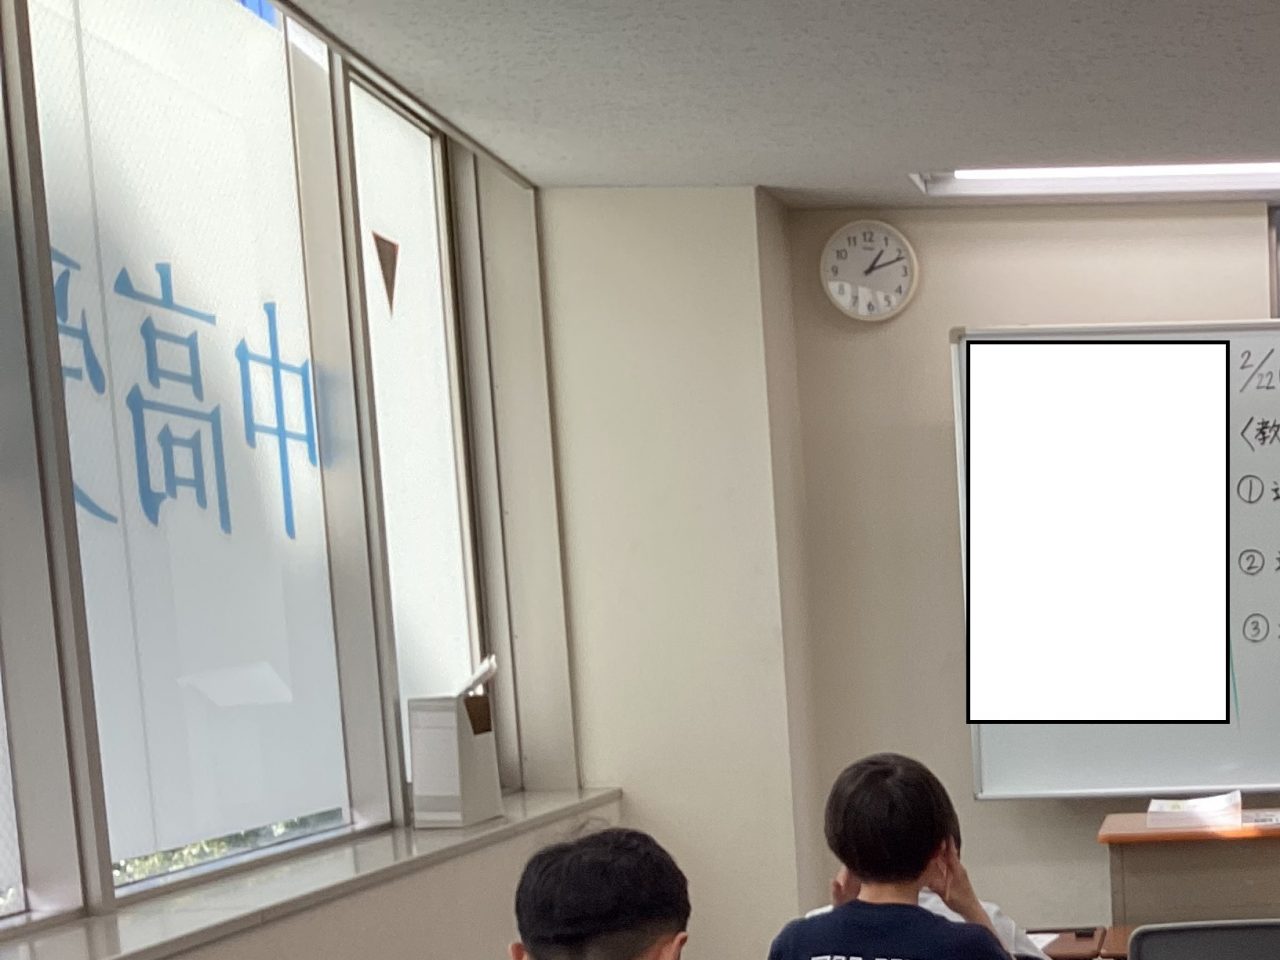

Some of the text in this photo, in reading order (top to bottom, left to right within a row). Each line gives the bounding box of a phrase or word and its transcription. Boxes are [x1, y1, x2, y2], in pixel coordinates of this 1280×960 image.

[847, 236, 857, 247] 11
[862, 231, 874, 243] 12
[836, 249, 848, 260] 10
[831, 265, 838, 276] 9
[901, 265, 908, 277] 3
[894, 284, 902, 294] 4
[867, 302, 875, 312] 6
